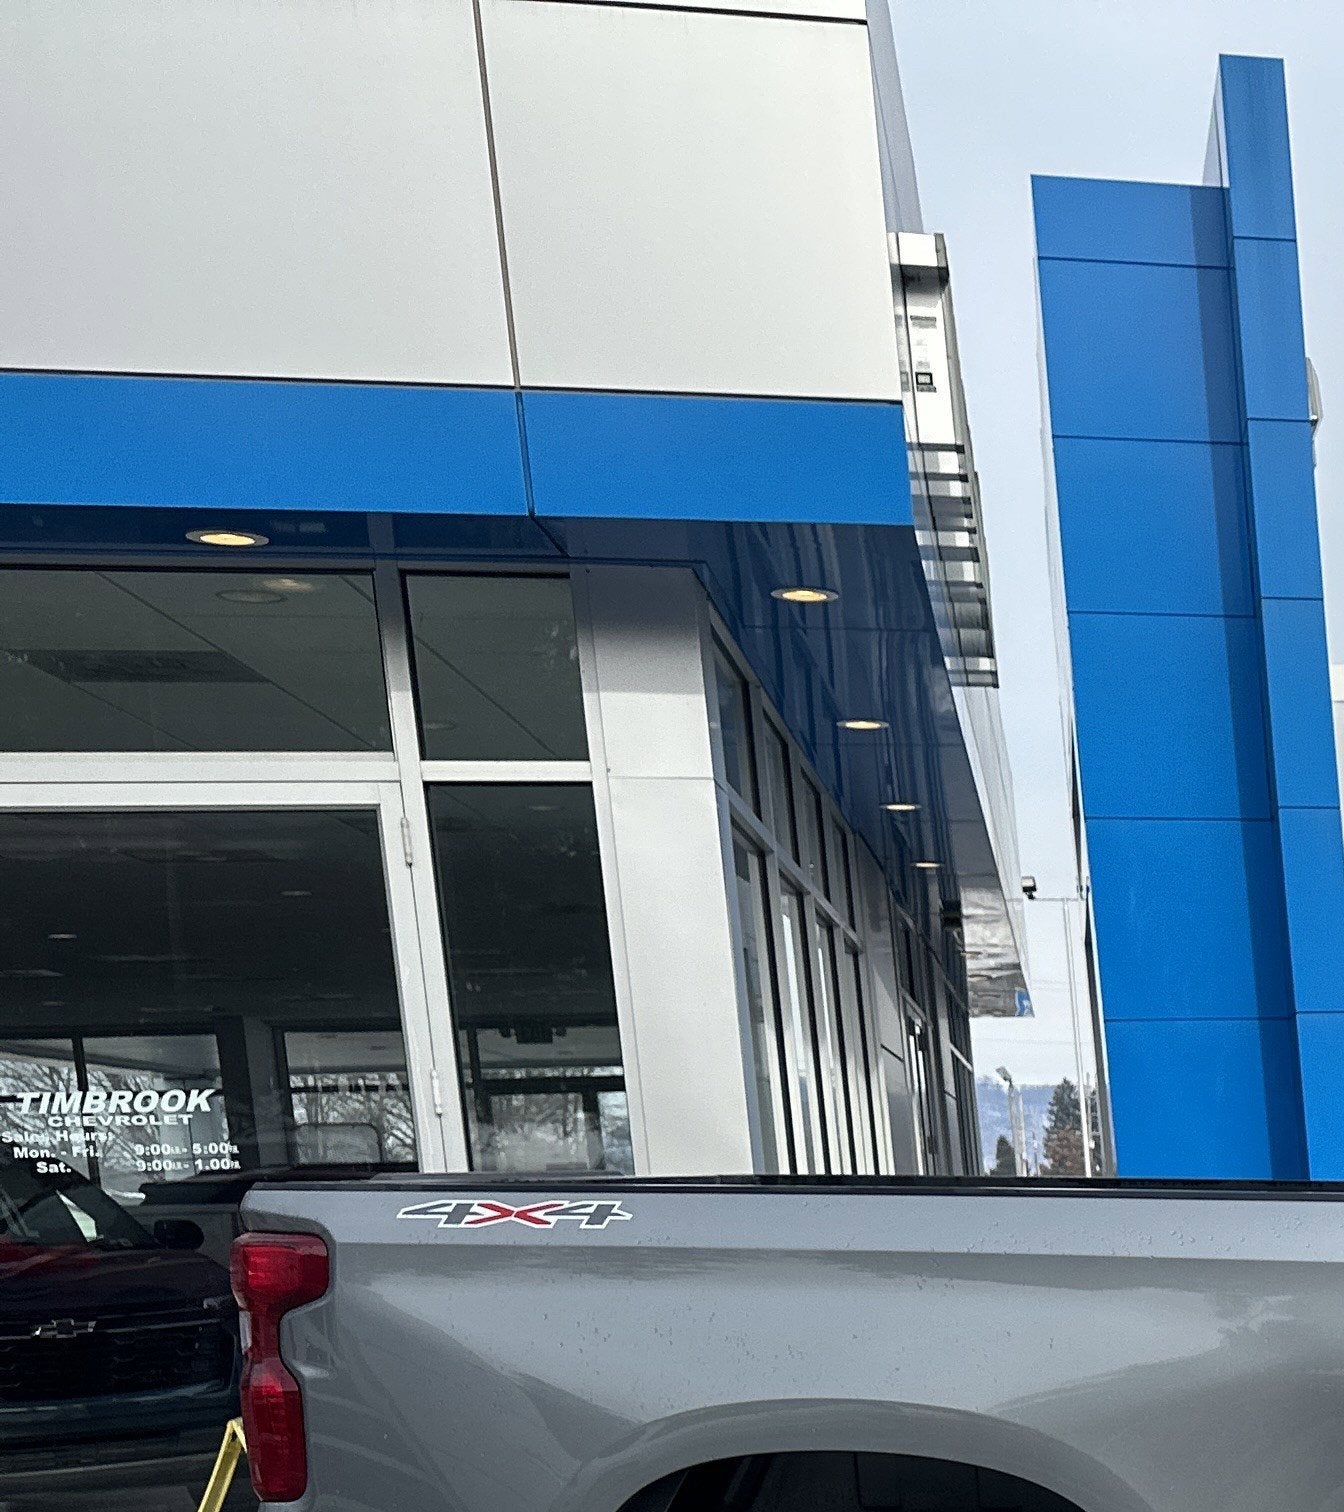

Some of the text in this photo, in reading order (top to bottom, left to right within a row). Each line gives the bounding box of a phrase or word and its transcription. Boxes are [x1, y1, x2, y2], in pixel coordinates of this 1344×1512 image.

[16, 1089, 216, 1114] TIMBROOK
[48, 1114, 193, 1127] CHEVROLET
[13, 1147, 56, 1158] Mon.
[71, 1145, 100, 1158] Fri.
[36, 1161, 72, 1173] Sat.
